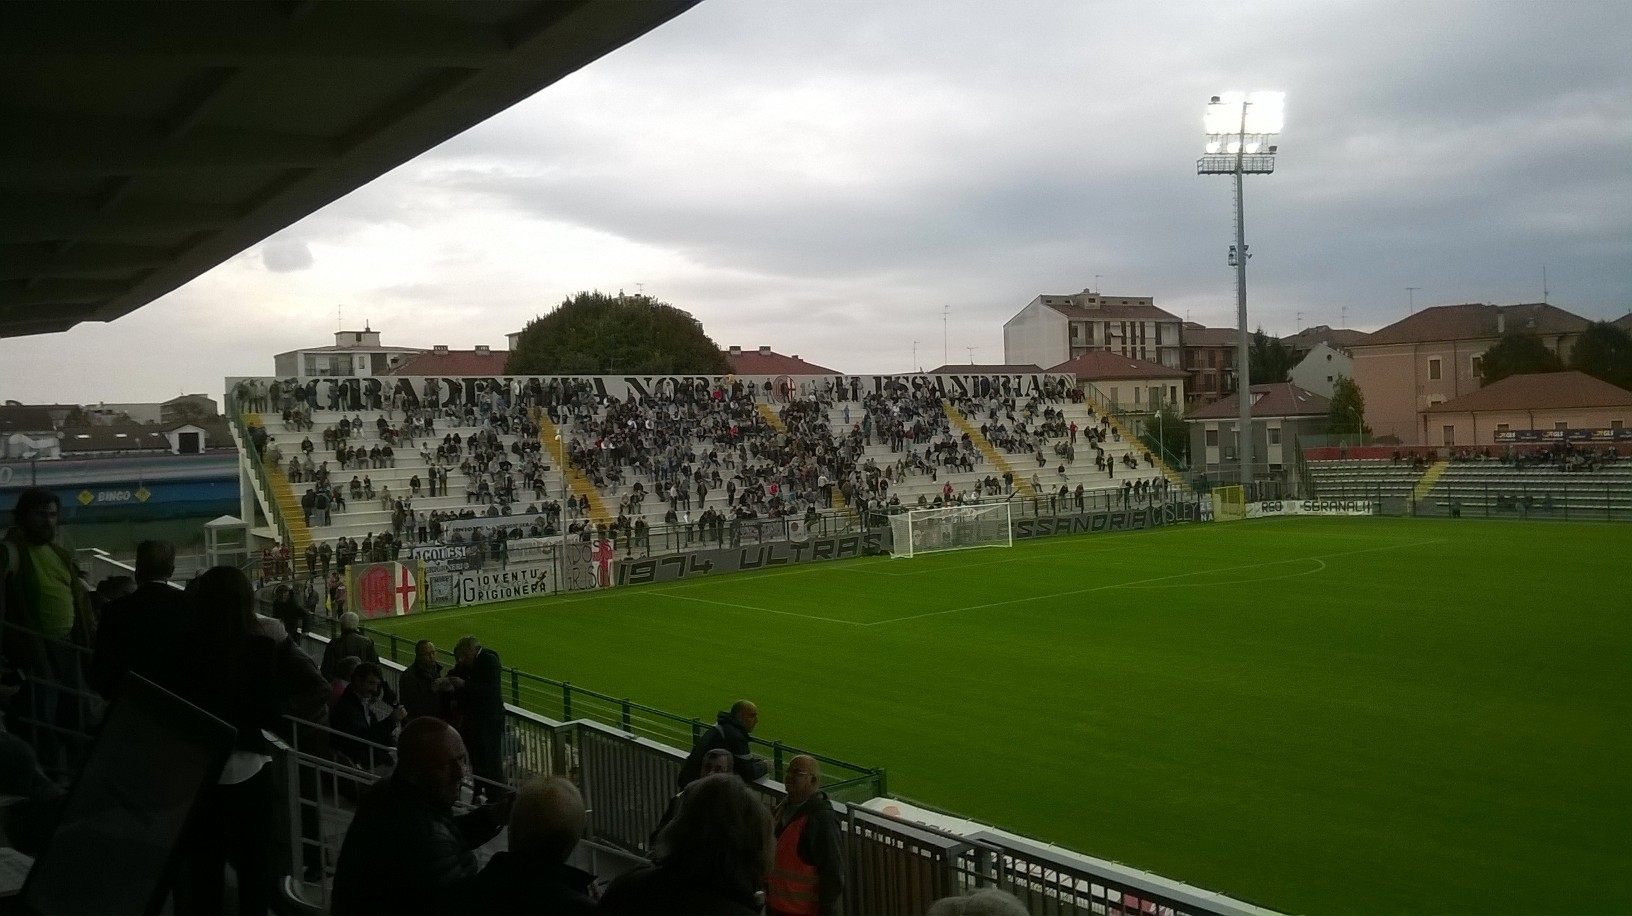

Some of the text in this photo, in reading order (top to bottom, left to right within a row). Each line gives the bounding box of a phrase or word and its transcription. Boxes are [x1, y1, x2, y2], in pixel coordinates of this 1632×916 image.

[97, 491, 131, 502] BINGO
[618, 555, 714, 585] 1974
[739, 533, 883, 570] ULTRAS
